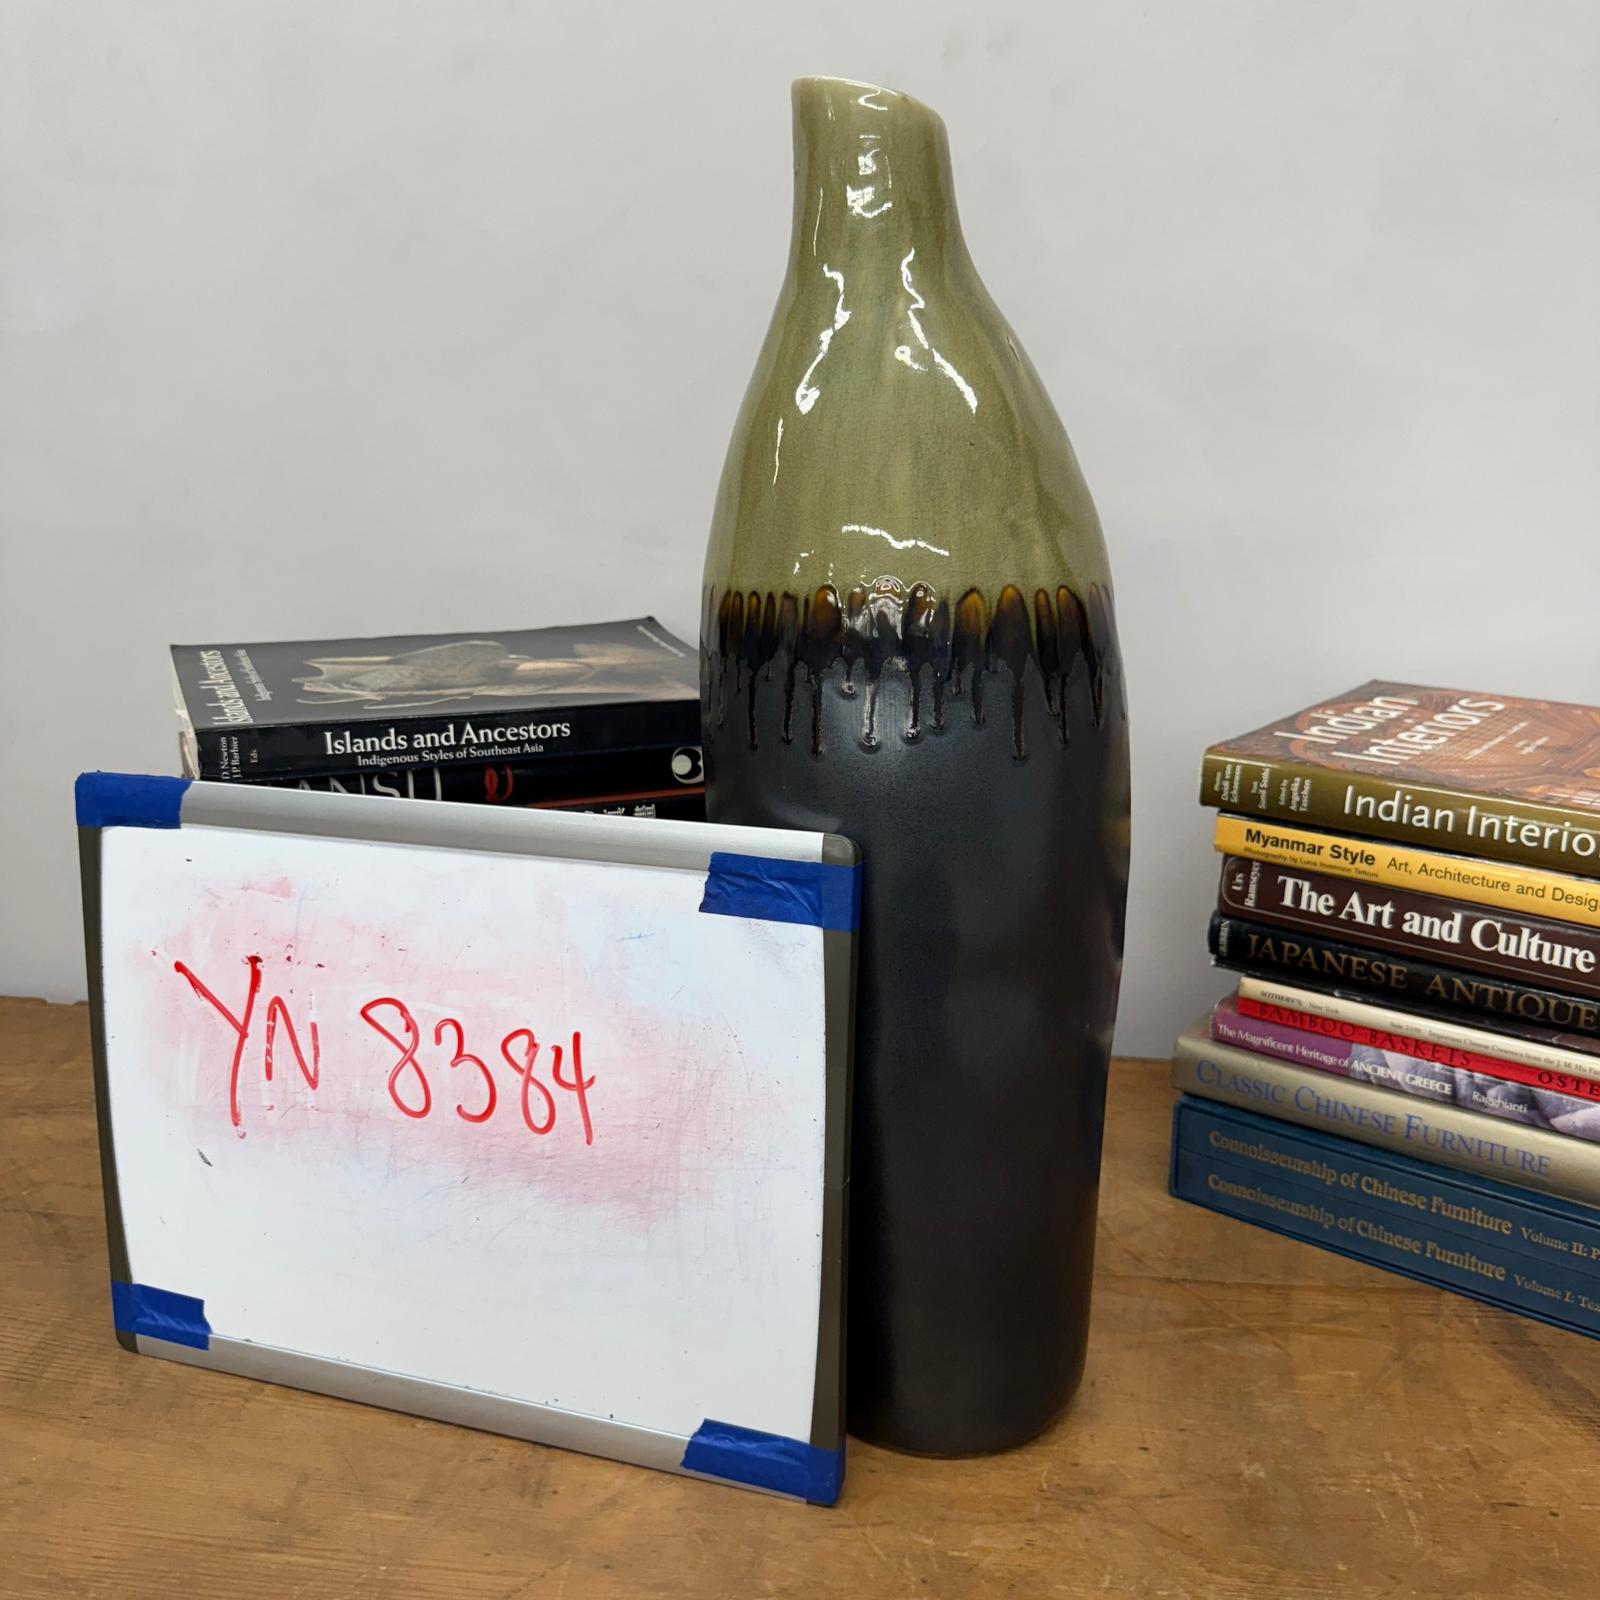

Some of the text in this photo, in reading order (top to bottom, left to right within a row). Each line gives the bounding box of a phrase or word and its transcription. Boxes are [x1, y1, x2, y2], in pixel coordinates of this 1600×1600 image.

[205, 698, 254, 725] Islands
[323, 721, 571, 756] Islands and Ancestors
[1273, 695, 1419, 745] Indian
[1331, 698, 1505, 765] Interiors
[221, 736, 230, 770] Newton
[230, 736, 241, 766] Barbier
[357, 741, 544, 768] Indigenous Styles of Southeast Asia
[1343, 784, 1600, 858] Indian Interio
[1244, 828, 1600, 912] Myanmar Style Art, Architecture and Desig
[1277, 875, 1596, 974] The Art and Culture
[1246, 933, 1599, 1031] JAPANESE ANTIQUE
[173, 955, 596, 1146] YN 8384
[1217, 1023, 1237, 1039] The
[1237, 1029, 1294, 1054] Magnificent
[1295, 1044, 1337, 1066] Heritage
[1338, 1054, 1349, 1068] of
[1350, 1059, 1403, 1086] ANCIENT
[1405, 1073, 1452, 1096] GREECE
[1368, 1029, 1471, 1067] BASKETS
[1195, 1058, 1551, 1177] CLASSIC CHINESE FURNITURE
[1208, 1129, 1337, 1186] Connoisseurship
[1339, 1173, 1361, 1190] of
[1360, 1175, 1428, 1211] Chinese
[1430, 1193, 1513, 1236] Furniture
[1520, 1226, 1569, 1252] Volume
[1571, 1241, 1588, 1258] II:
[1206, 1173, 1335, 1231] Connoisseurship
[1337, 1216, 1359, 1233] of
[1356, 1220, 1423, 1255] Chinese
[1424, 1239, 1508, 1282] Furniture
[1513, 1273, 1562, 1301] Volume
[1563, 1290, 1576, 1304] I:
